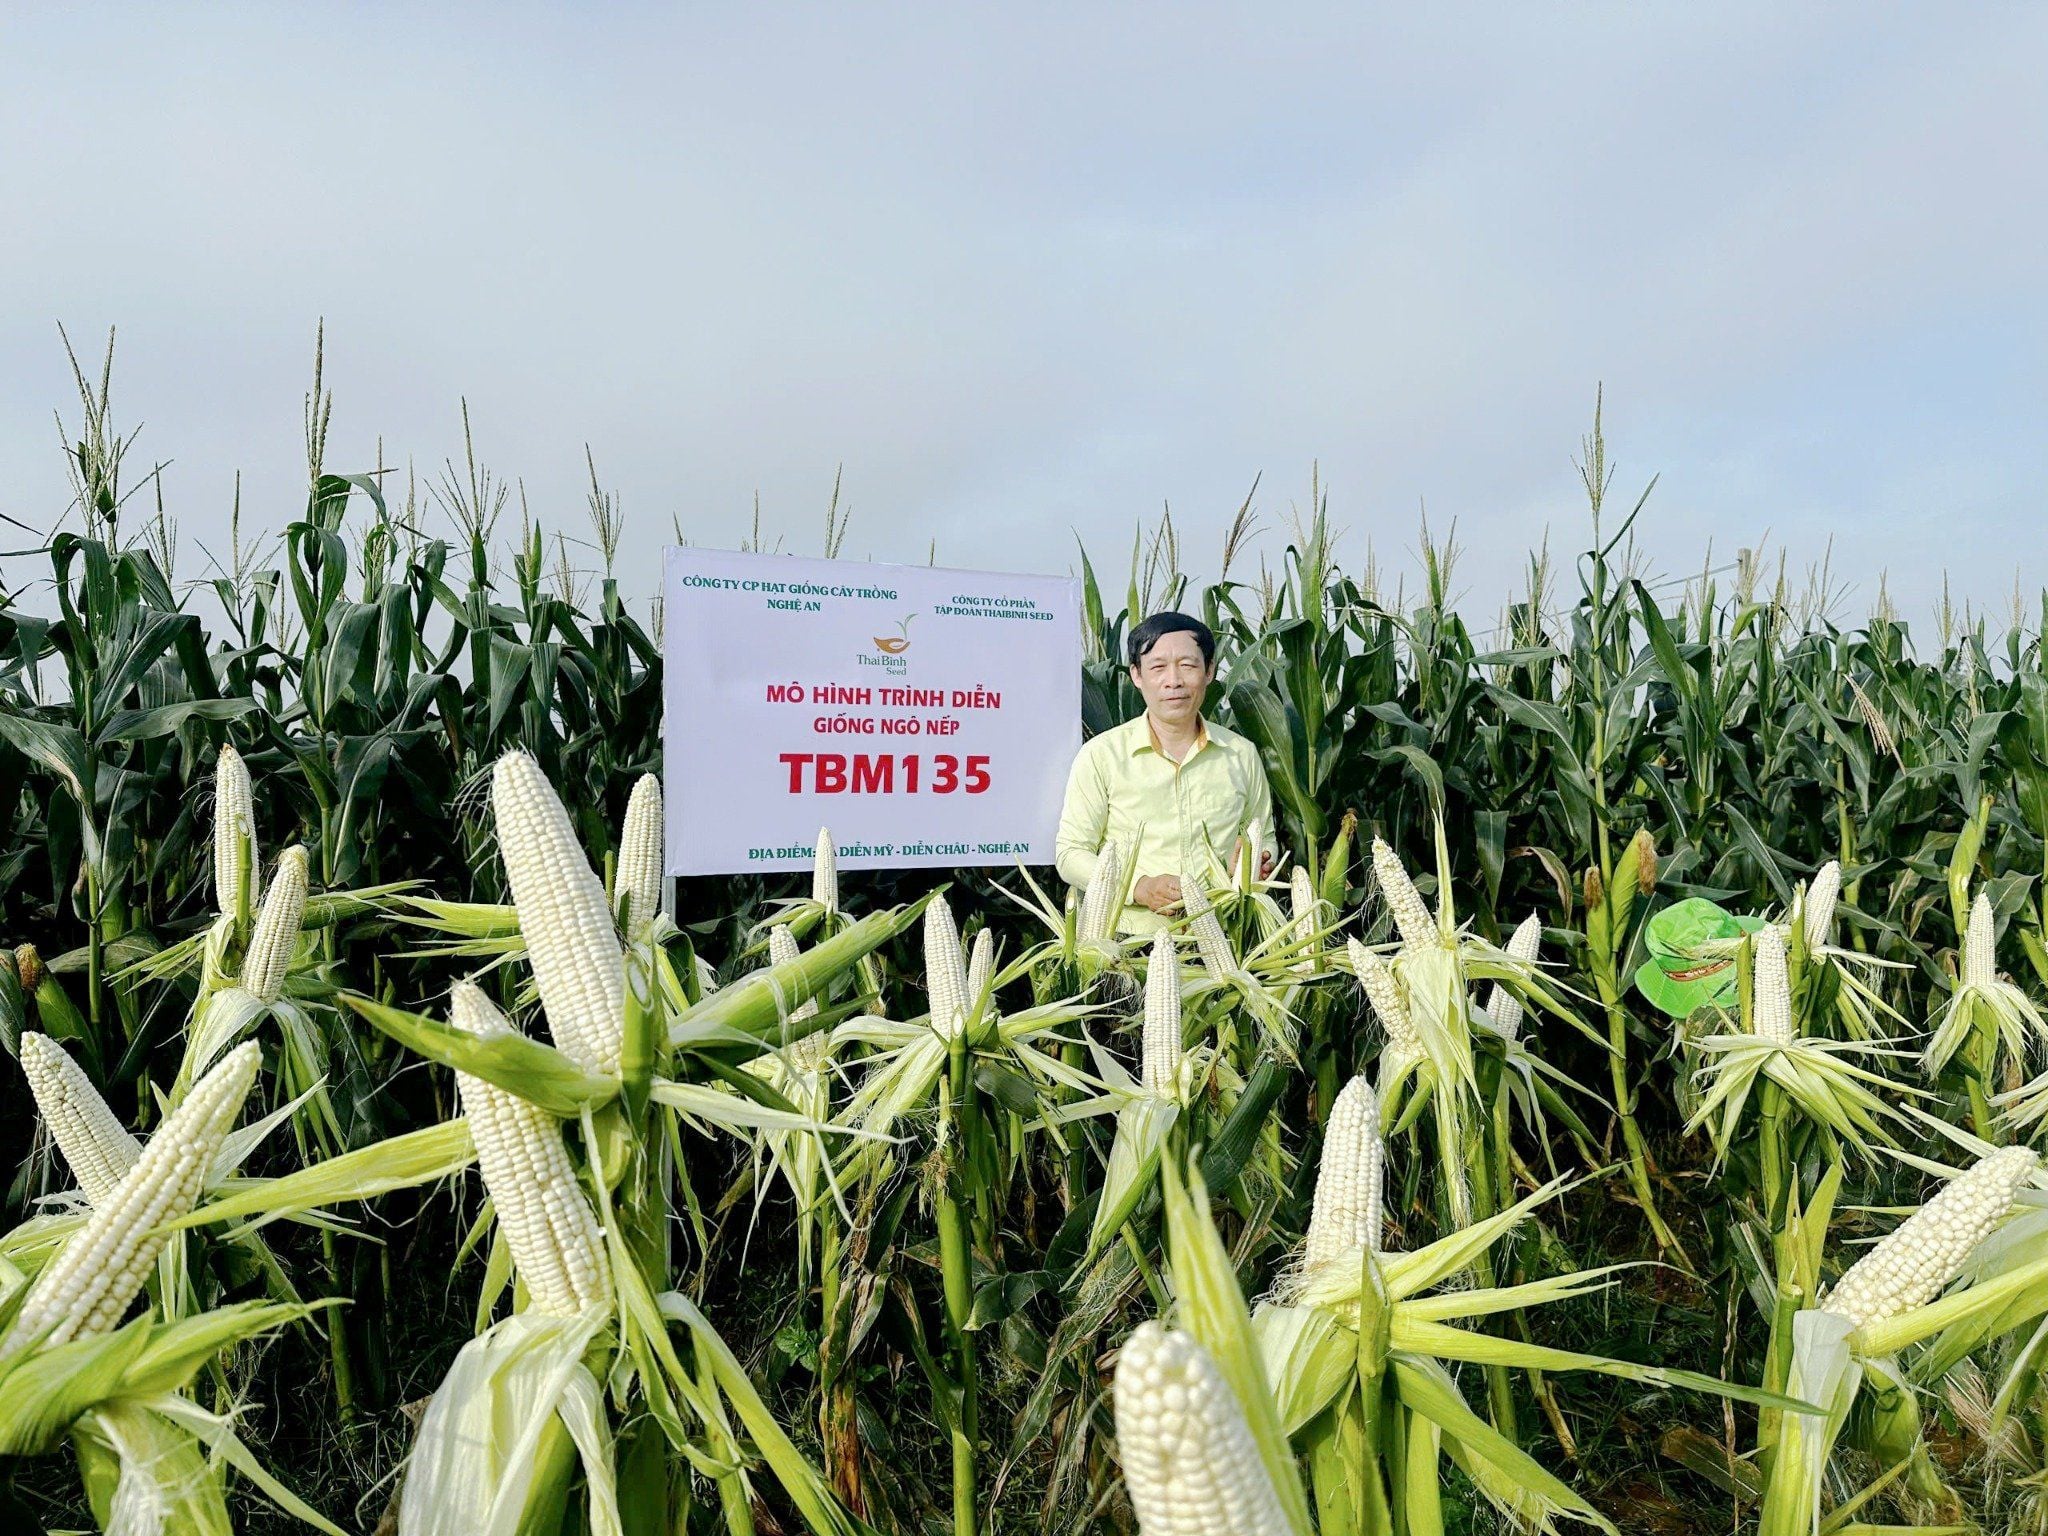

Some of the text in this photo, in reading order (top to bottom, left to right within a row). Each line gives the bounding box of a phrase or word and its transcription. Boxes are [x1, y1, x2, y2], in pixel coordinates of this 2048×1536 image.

[683, 574, 721, 588] CÔNG
[722, 579, 740, 589] TY
[742, 580, 760, 591] CP
[761, 582, 786, 595] HẠT
[788, 580, 829, 596] GIỐNG
[830, 585, 854, 597] CÂY
[766, 598, 821, 613] NGHỆ AN
[952, 594, 980, 606] CÔNG
[980, 598, 993, 606] TY
[934, 604, 953, 616] TẬP
[983, 609, 1028, 619] THAIBINH
[1029, 611, 1054, 621] SEED
[886, 667, 907, 676] Seed
[766, 681, 1001, 709] MÔ HÌNH TRÌNH DIỄN
[813, 712, 960, 736] GIỐNG NGÔ NẾP
[779, 753, 991, 794] TBM135
[748, 848, 774, 861] ĐỊA
[839, 841, 871, 857] DIỄN
[873, 844, 894, 857] MỸ
[902, 840, 933, 856] DIỄN
[935, 842, 970, 855] CHÂU
[977, 841, 1011, 856] NGHỆ
[1012, 843, 1030, 854] AN
